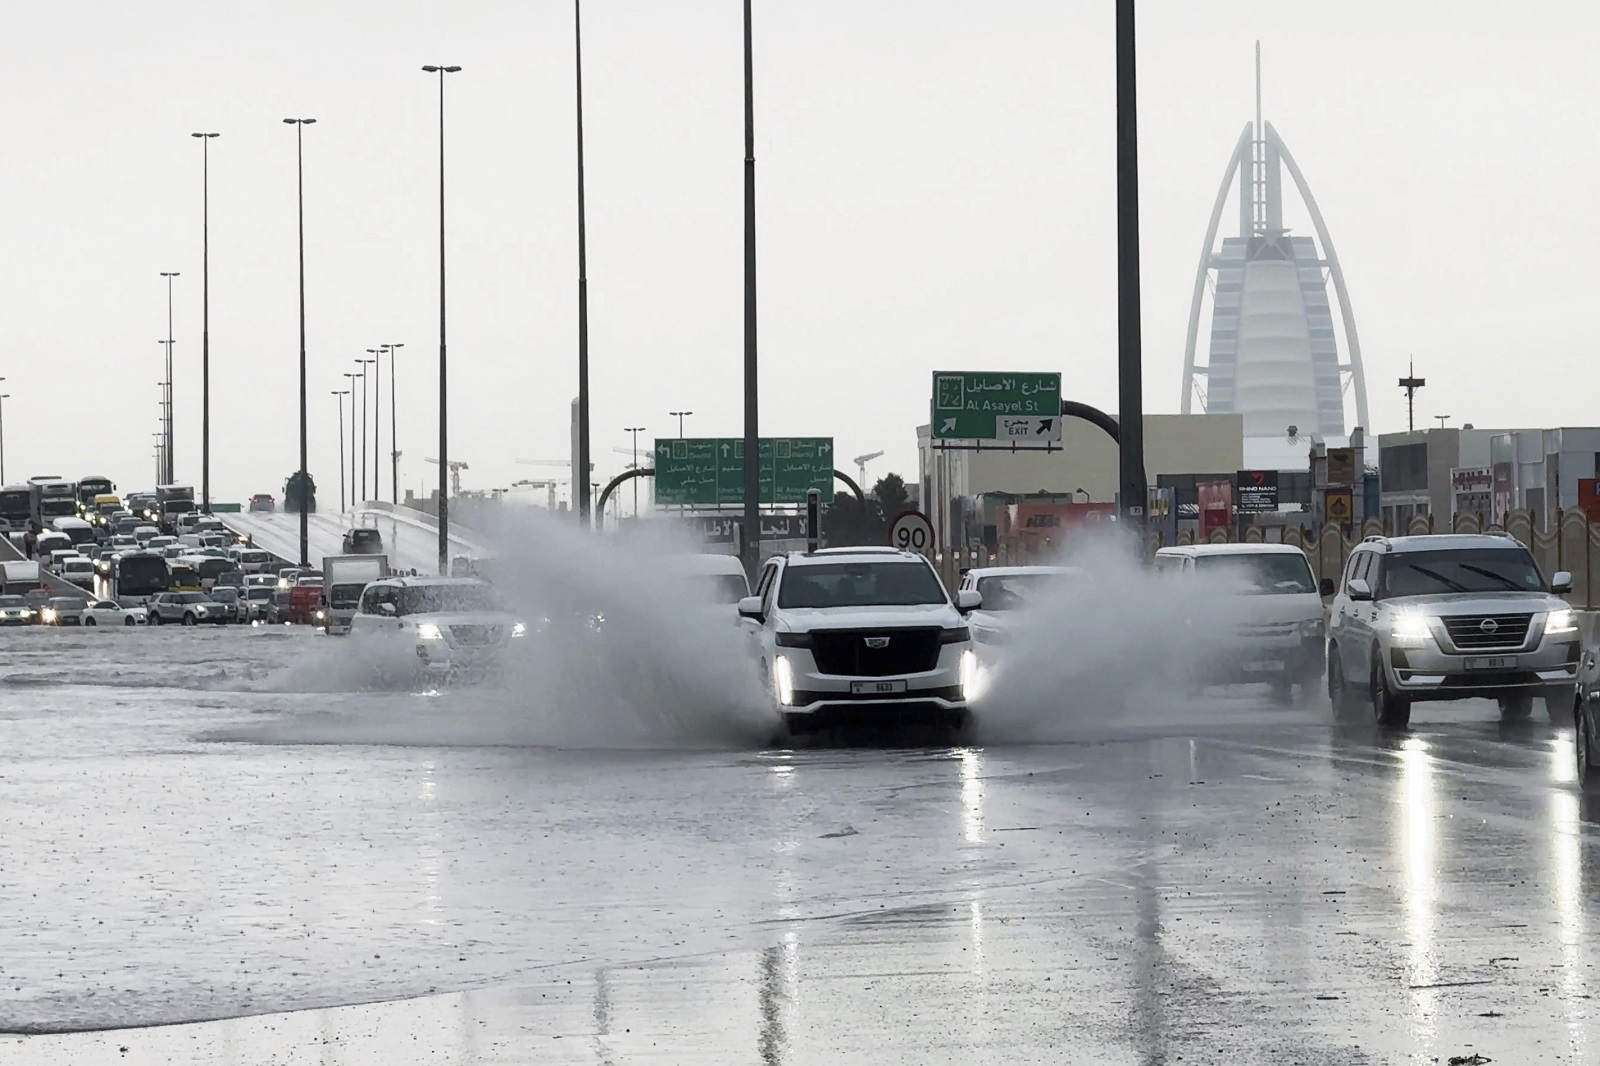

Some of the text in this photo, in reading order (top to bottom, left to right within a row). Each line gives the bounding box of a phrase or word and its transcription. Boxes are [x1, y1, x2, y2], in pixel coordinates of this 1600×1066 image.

[1021, 379, 1057, 395] شارع
[966, 400, 1039, 413] Al Asayel St
[1008, 427, 1028, 436] EXIT
[897, 527, 926, 549] 90
